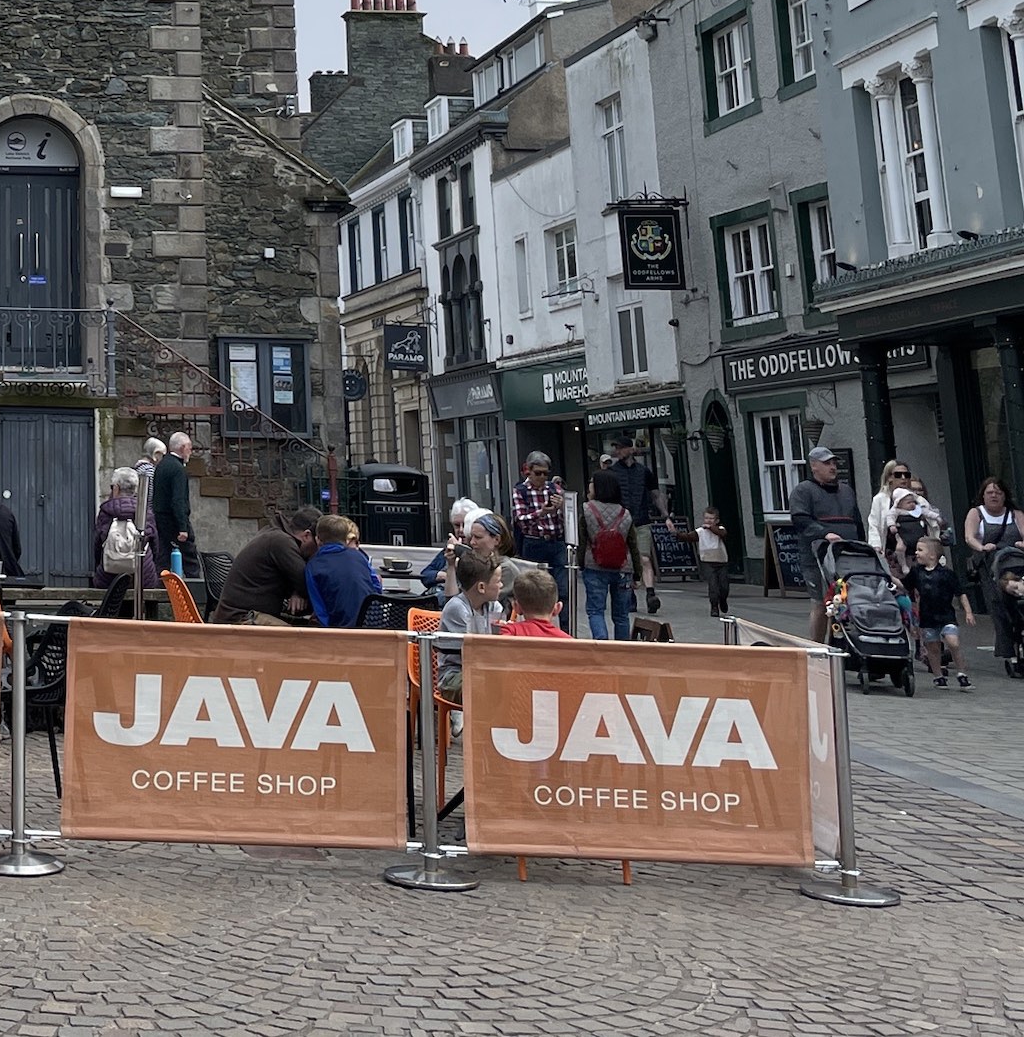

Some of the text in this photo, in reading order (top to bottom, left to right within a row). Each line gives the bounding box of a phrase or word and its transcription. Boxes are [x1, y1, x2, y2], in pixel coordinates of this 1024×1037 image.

[730, 358, 756, 381] THE
[758, 344, 860, 377] ODDFELLOW
[593, 405, 671, 424] MOUNTAIN WAREHOUSE
[93, 674, 376, 753] JAVA
[491, 689, 778, 771] JAVA
[131, 769, 336, 795] COFFEE SHOP
[533, 785, 741, 813] COFFEE SHOP
